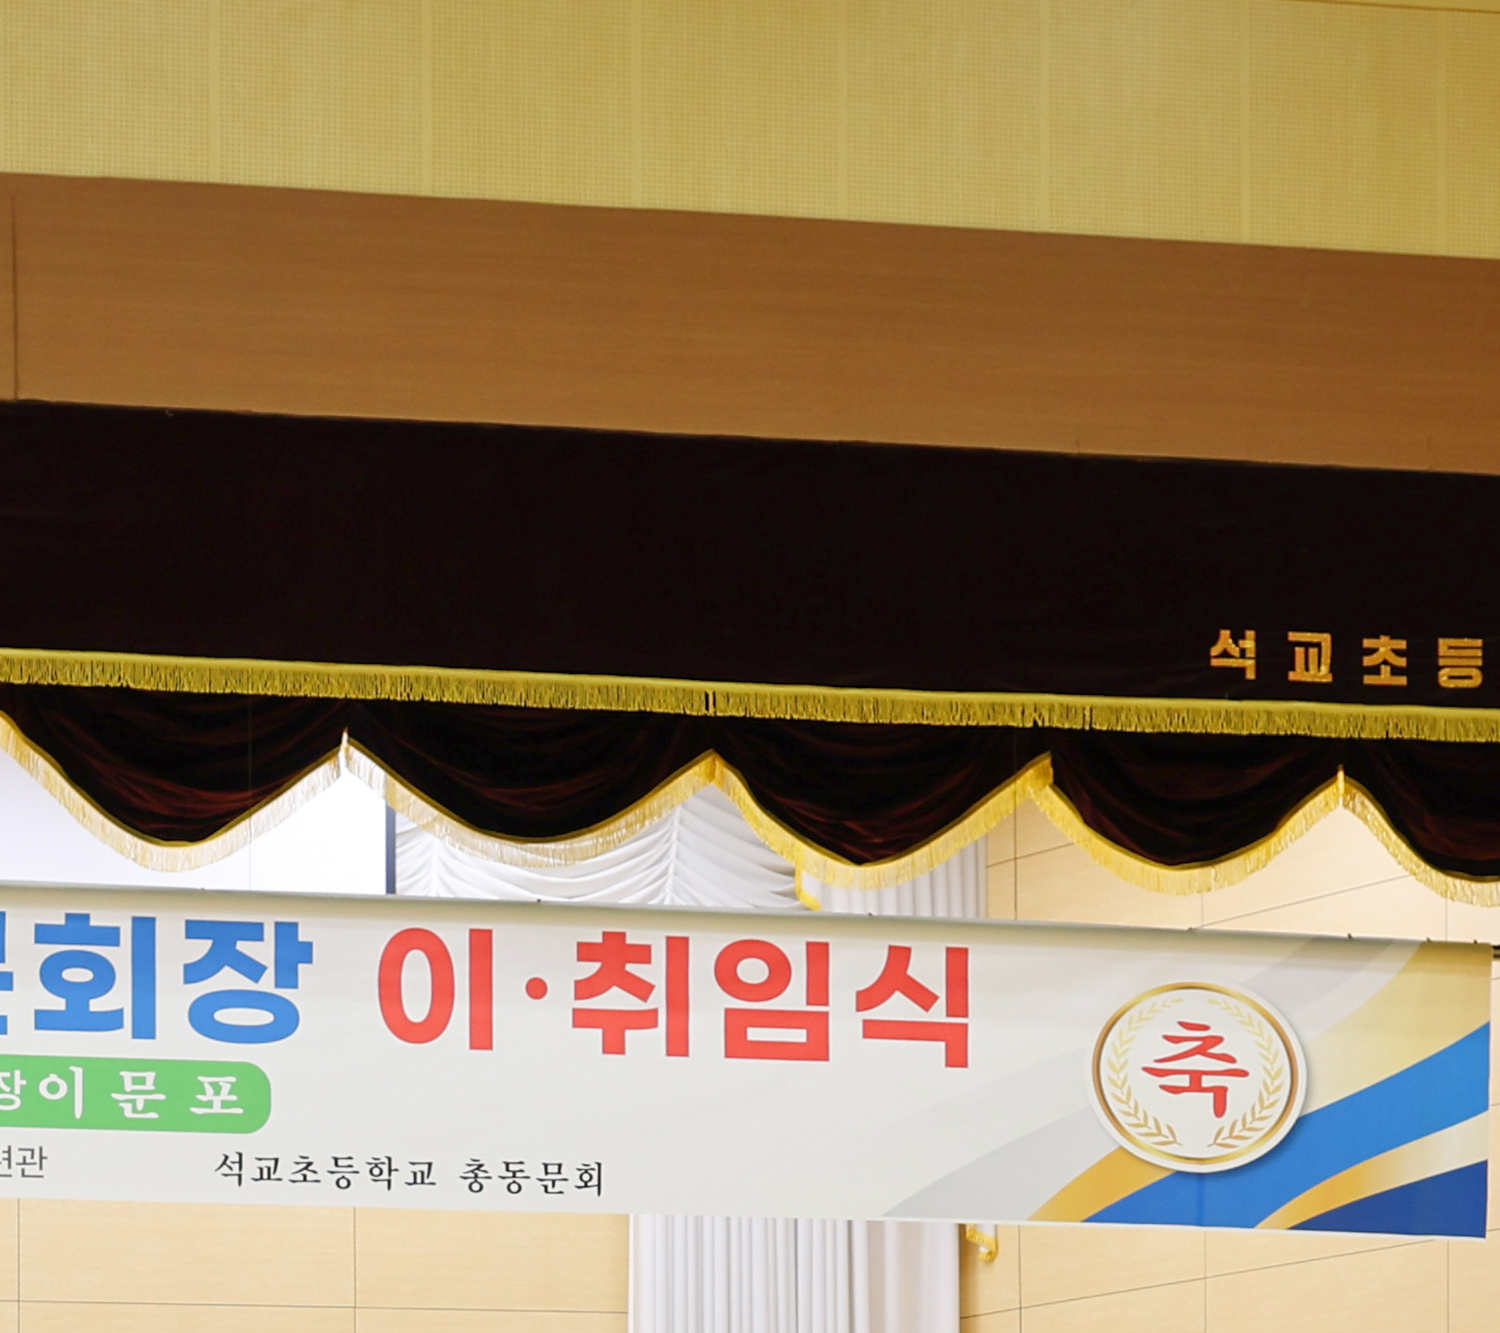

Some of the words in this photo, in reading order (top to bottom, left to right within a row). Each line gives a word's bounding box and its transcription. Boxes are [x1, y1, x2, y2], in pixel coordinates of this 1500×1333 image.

[379, 927, 970, 1068] 이·취임식
[1142, 1021, 1250, 1118] 축
[215, 1150, 437, 1190] 석교초등학교
[459, 1156, 602, 1197] 총동문회
